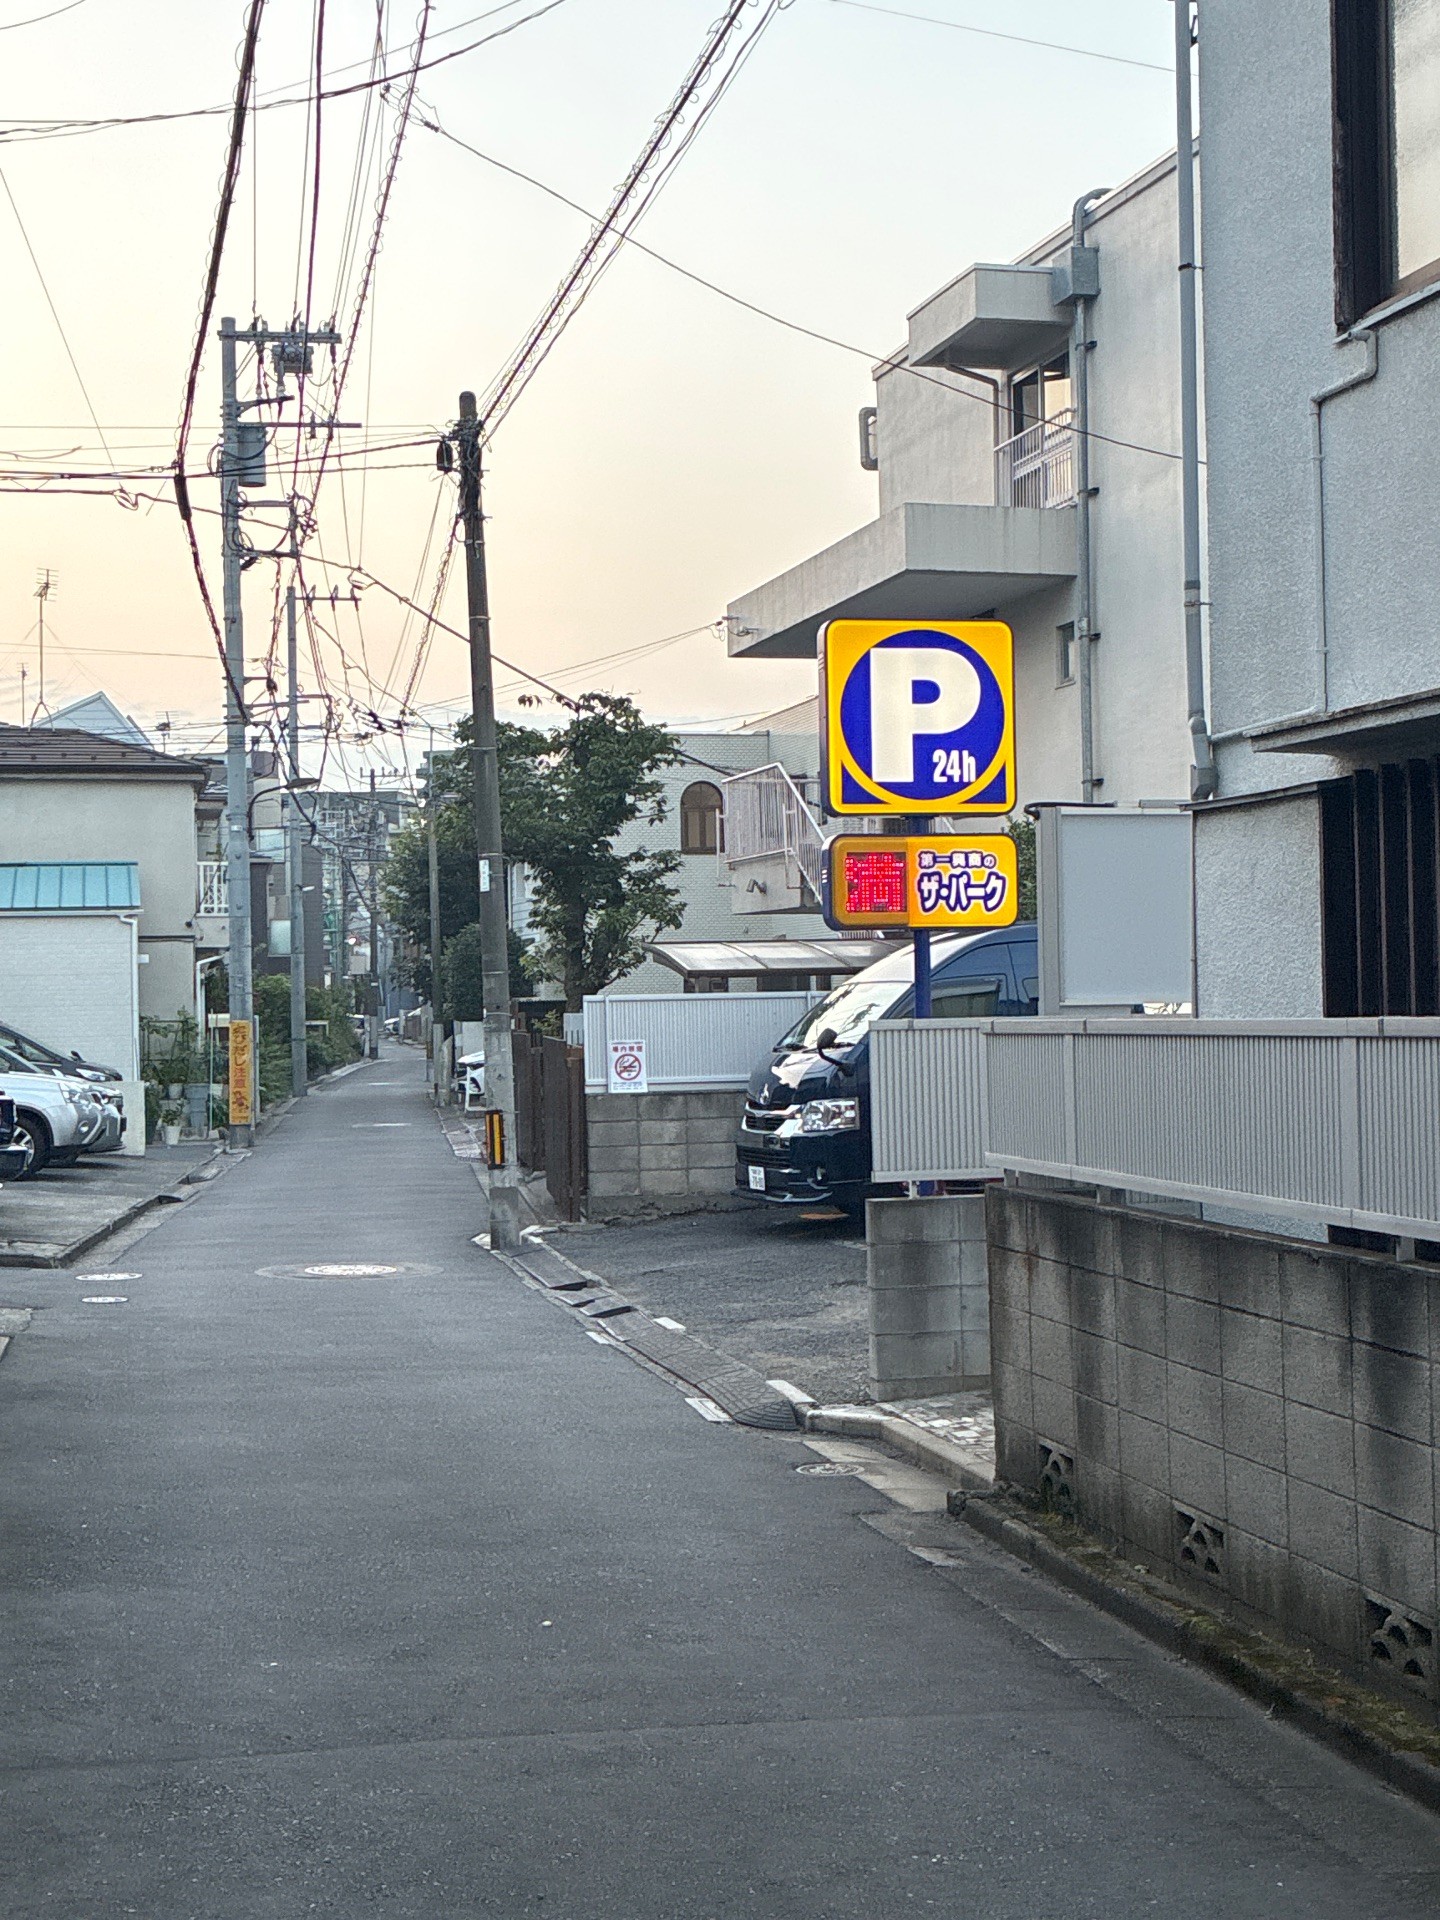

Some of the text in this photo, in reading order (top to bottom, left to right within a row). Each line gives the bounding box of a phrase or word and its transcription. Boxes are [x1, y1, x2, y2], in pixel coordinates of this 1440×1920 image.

[870, 647, 981, 783] P
[932, 749, 976, 783] 24h
[919, 851, 996, 868] 第一興商の
[845, 855, 904, 911] 満
[919, 872, 1005, 911] ザ・パーク
